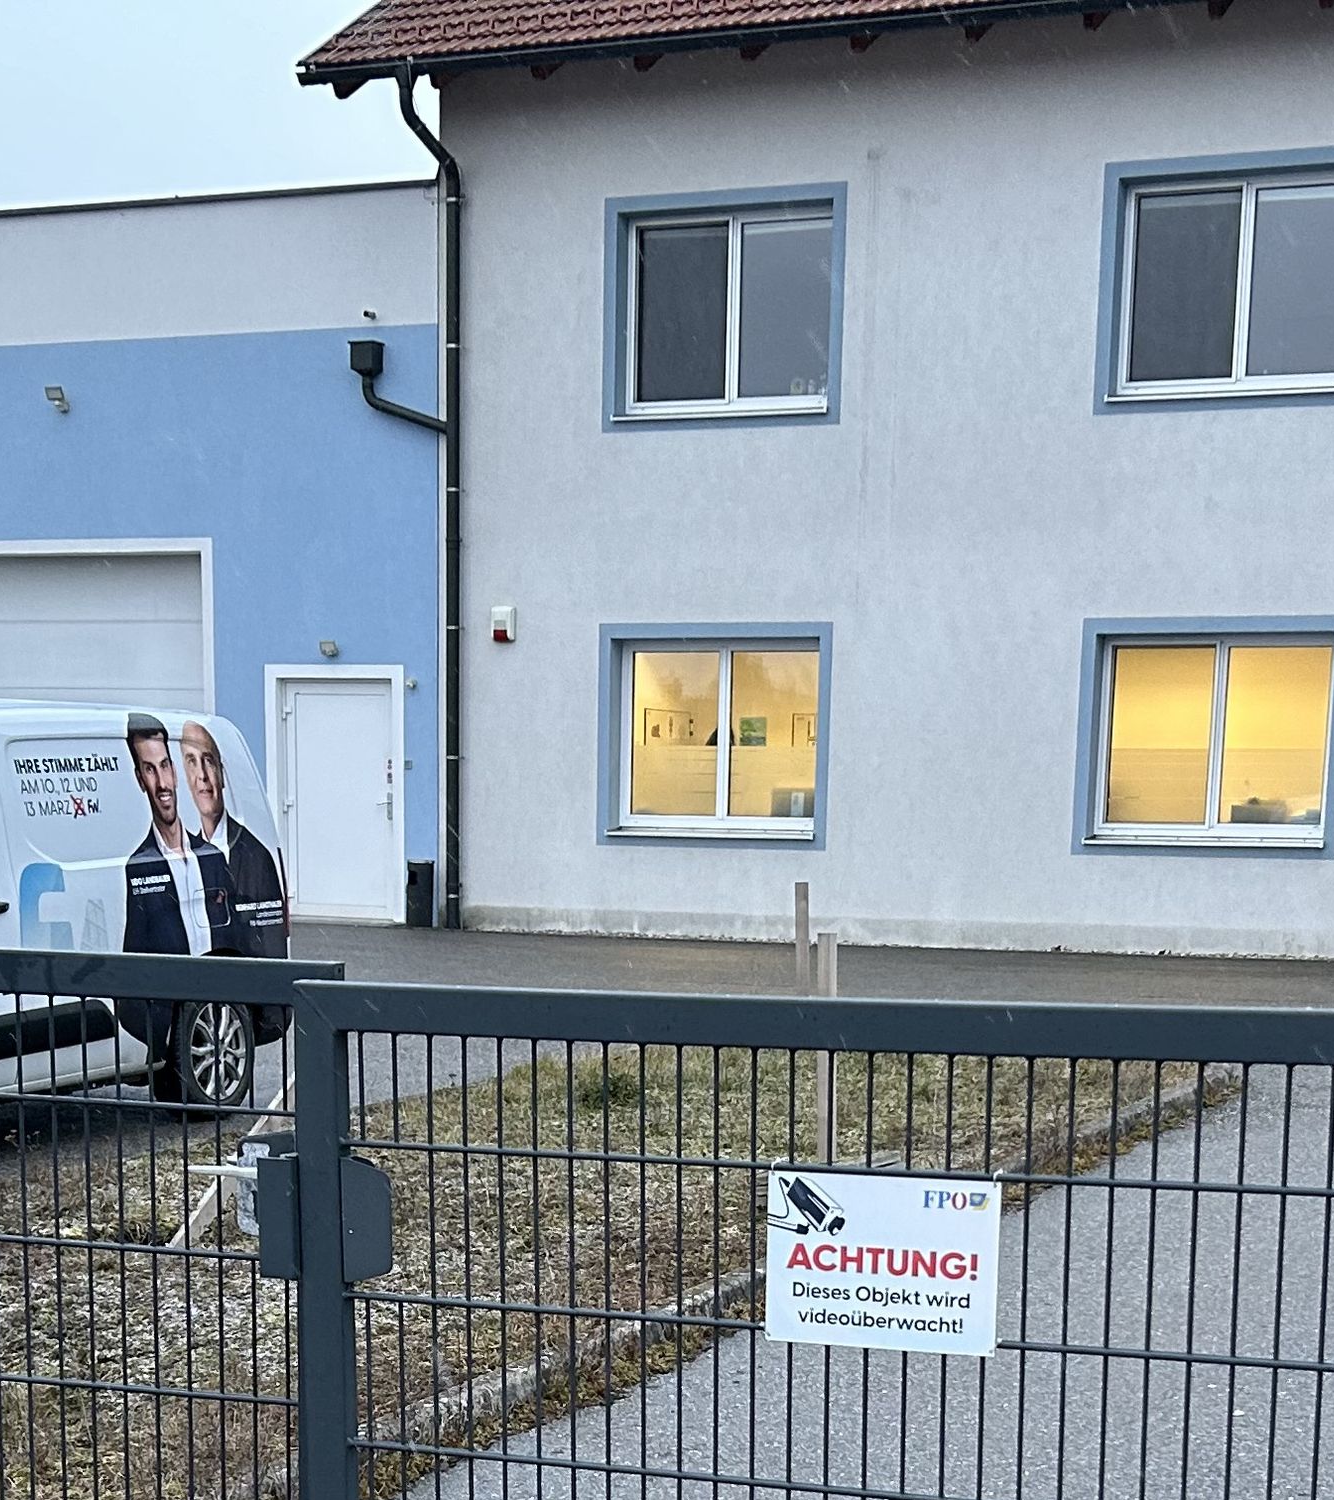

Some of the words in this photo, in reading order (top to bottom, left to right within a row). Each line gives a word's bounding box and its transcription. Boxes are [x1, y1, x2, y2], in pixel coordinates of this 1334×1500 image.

[13, 758, 42, 774] IHRE
[42, 757, 85, 773] STIMME
[85, 753, 119, 771] ZÄHLT
[20, 779, 40, 794] AM
[74, 776, 98, 792] UND
[786, 1242, 979, 1282] ACHTUNG!
[792, 1281, 851, 1301] Dieses
[855, 1286, 921, 1307] Objekt
[925, 1291, 971, 1309] wird
[798, 1307, 964, 1334] videoüberwacht!
